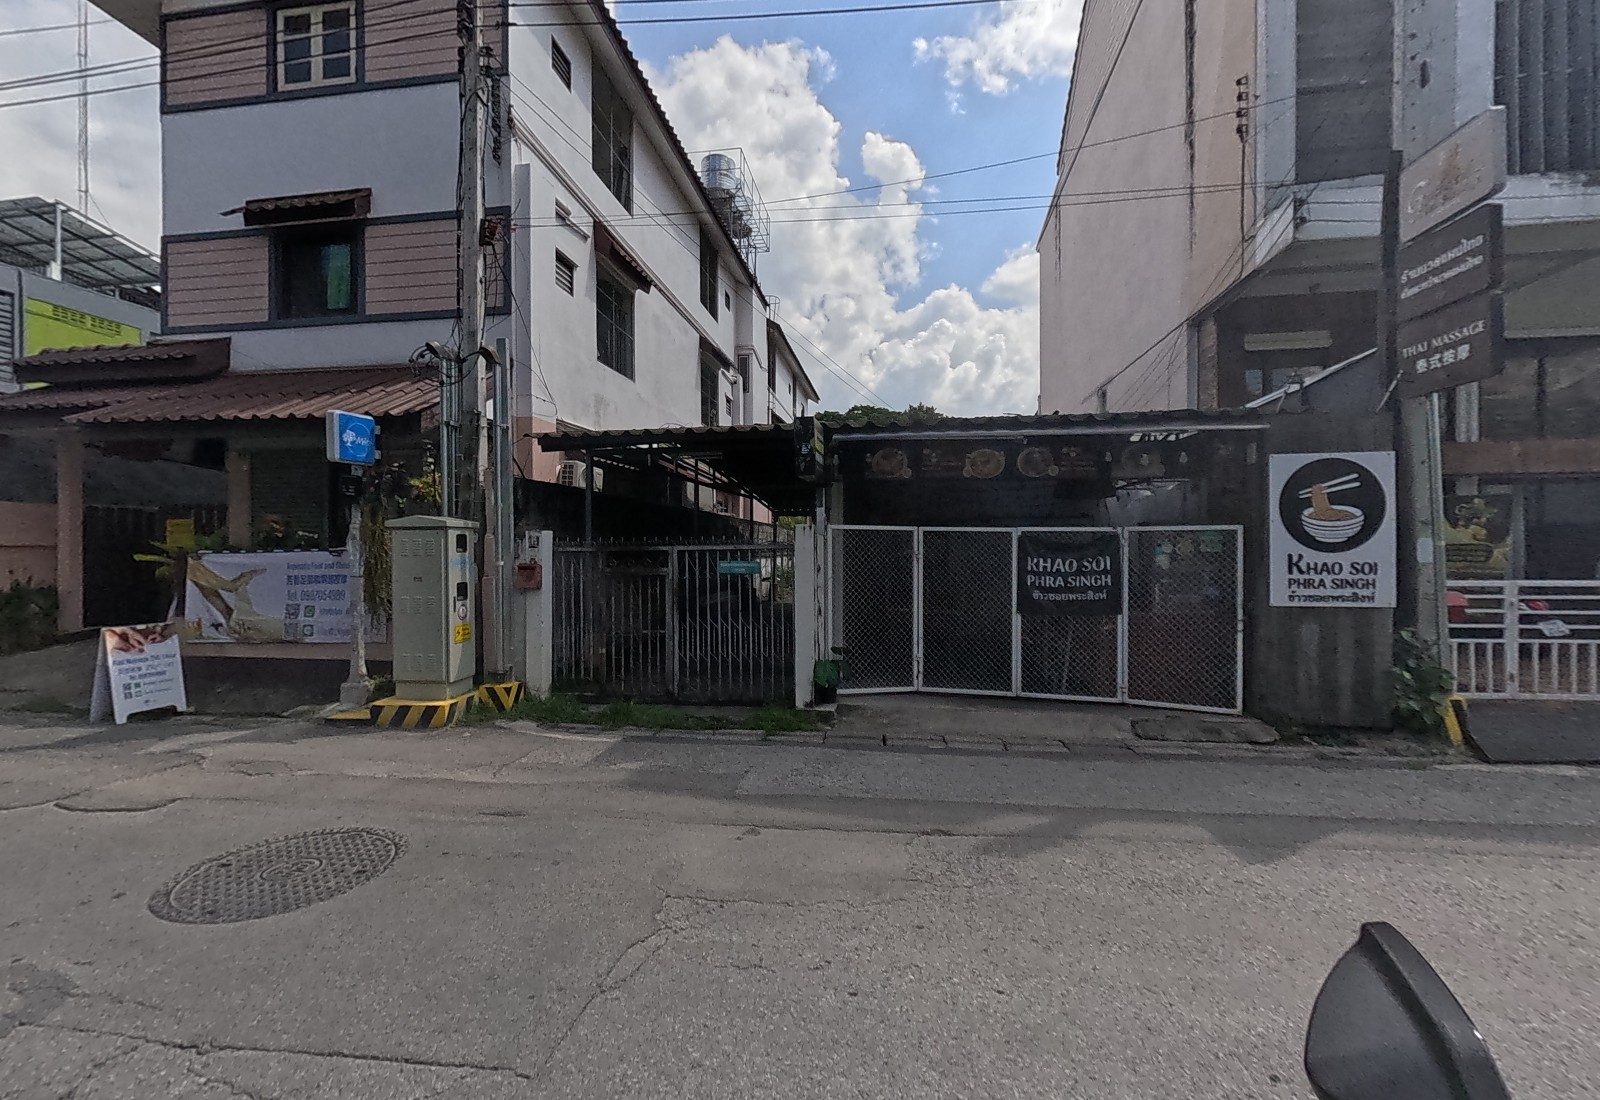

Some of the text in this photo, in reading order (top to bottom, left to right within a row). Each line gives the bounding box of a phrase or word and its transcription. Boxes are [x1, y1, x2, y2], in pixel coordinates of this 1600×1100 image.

[1402, 319, 1486, 358] THAI MASSAGE
[1026, 555, 1111, 573] KHAO SOI
[1287, 553, 1378, 576] KHAO SOI
[1026, 574, 1112, 588] PHRA SINGH
[1287, 578, 1377, 590] PHRA SINGH
